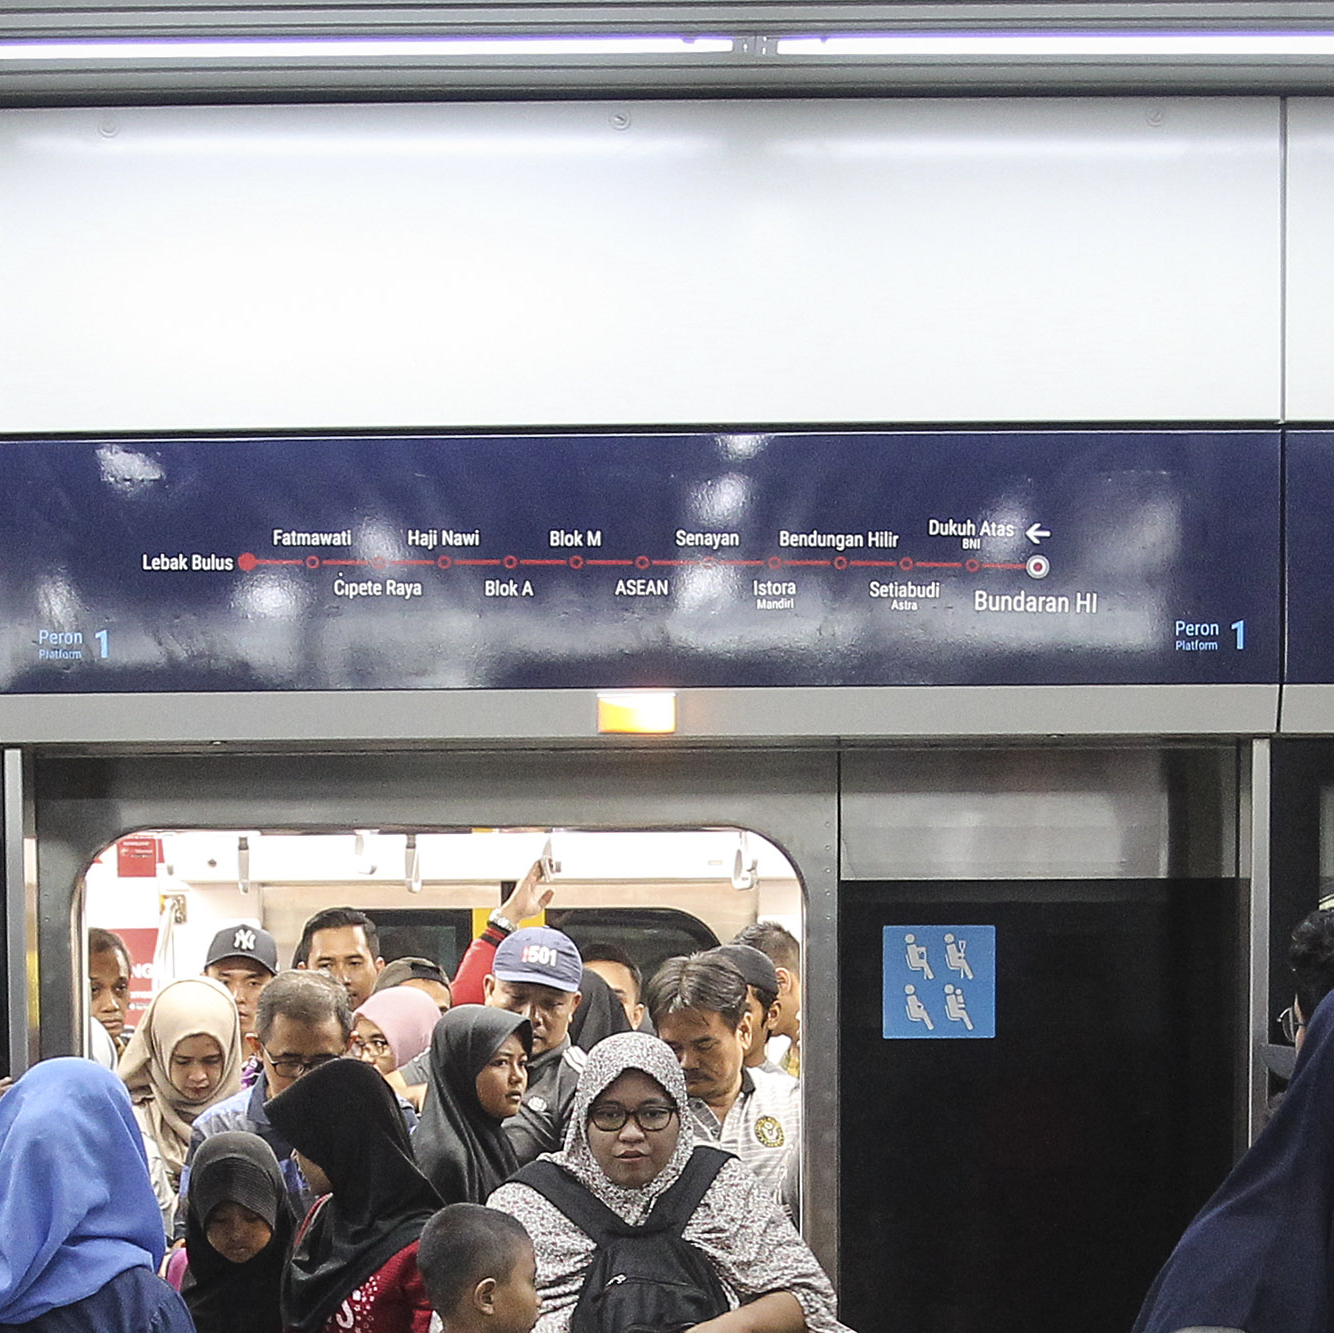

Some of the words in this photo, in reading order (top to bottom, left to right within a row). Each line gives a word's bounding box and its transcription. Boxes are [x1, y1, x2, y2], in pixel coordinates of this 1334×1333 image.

[928, 519, 976, 536] Dukuh
[979, 520, 1015, 537] Atas
[273, 530, 351, 546] Fatmawati
[408, 530, 437, 549] Haji
[442, 530, 479, 546] Nawi
[549, 530, 584, 547] Blok
[587, 531, 602, 547] M
[675, 530, 739, 549] Senayan
[780, 531, 863, 550] Bendungan
[868, 532, 899, 547] Hilir
[962, 538, 980, 549] BNI
[142, 554, 188, 570] Lebak
[192, 555, 233, 570] Bulus
[334, 576, 382, 599] Cipete
[386, 580, 422, 599] Raya
[485, 580, 518, 596] Blok
[520, 581, 534, 596] A
[615, 580, 668, 595] ASEAN
[753, 580, 796, 596] Istora
[869, 581, 940, 598] Setiabudi
[756, 598, 794, 609] Mandiri
[891, 600, 918, 611] Astra
[974, 590, 1068, 613] Bundaran
[1076, 592, 1097, 613] HI
[1175, 620, 1219, 636] Peron
[1231, 620, 1244, 650] 1
[39, 629, 83, 645] Peron
[95, 629, 109, 659] 1
[1175, 640, 1218, 651] Platform
[38, 650, 82, 660] Platform
